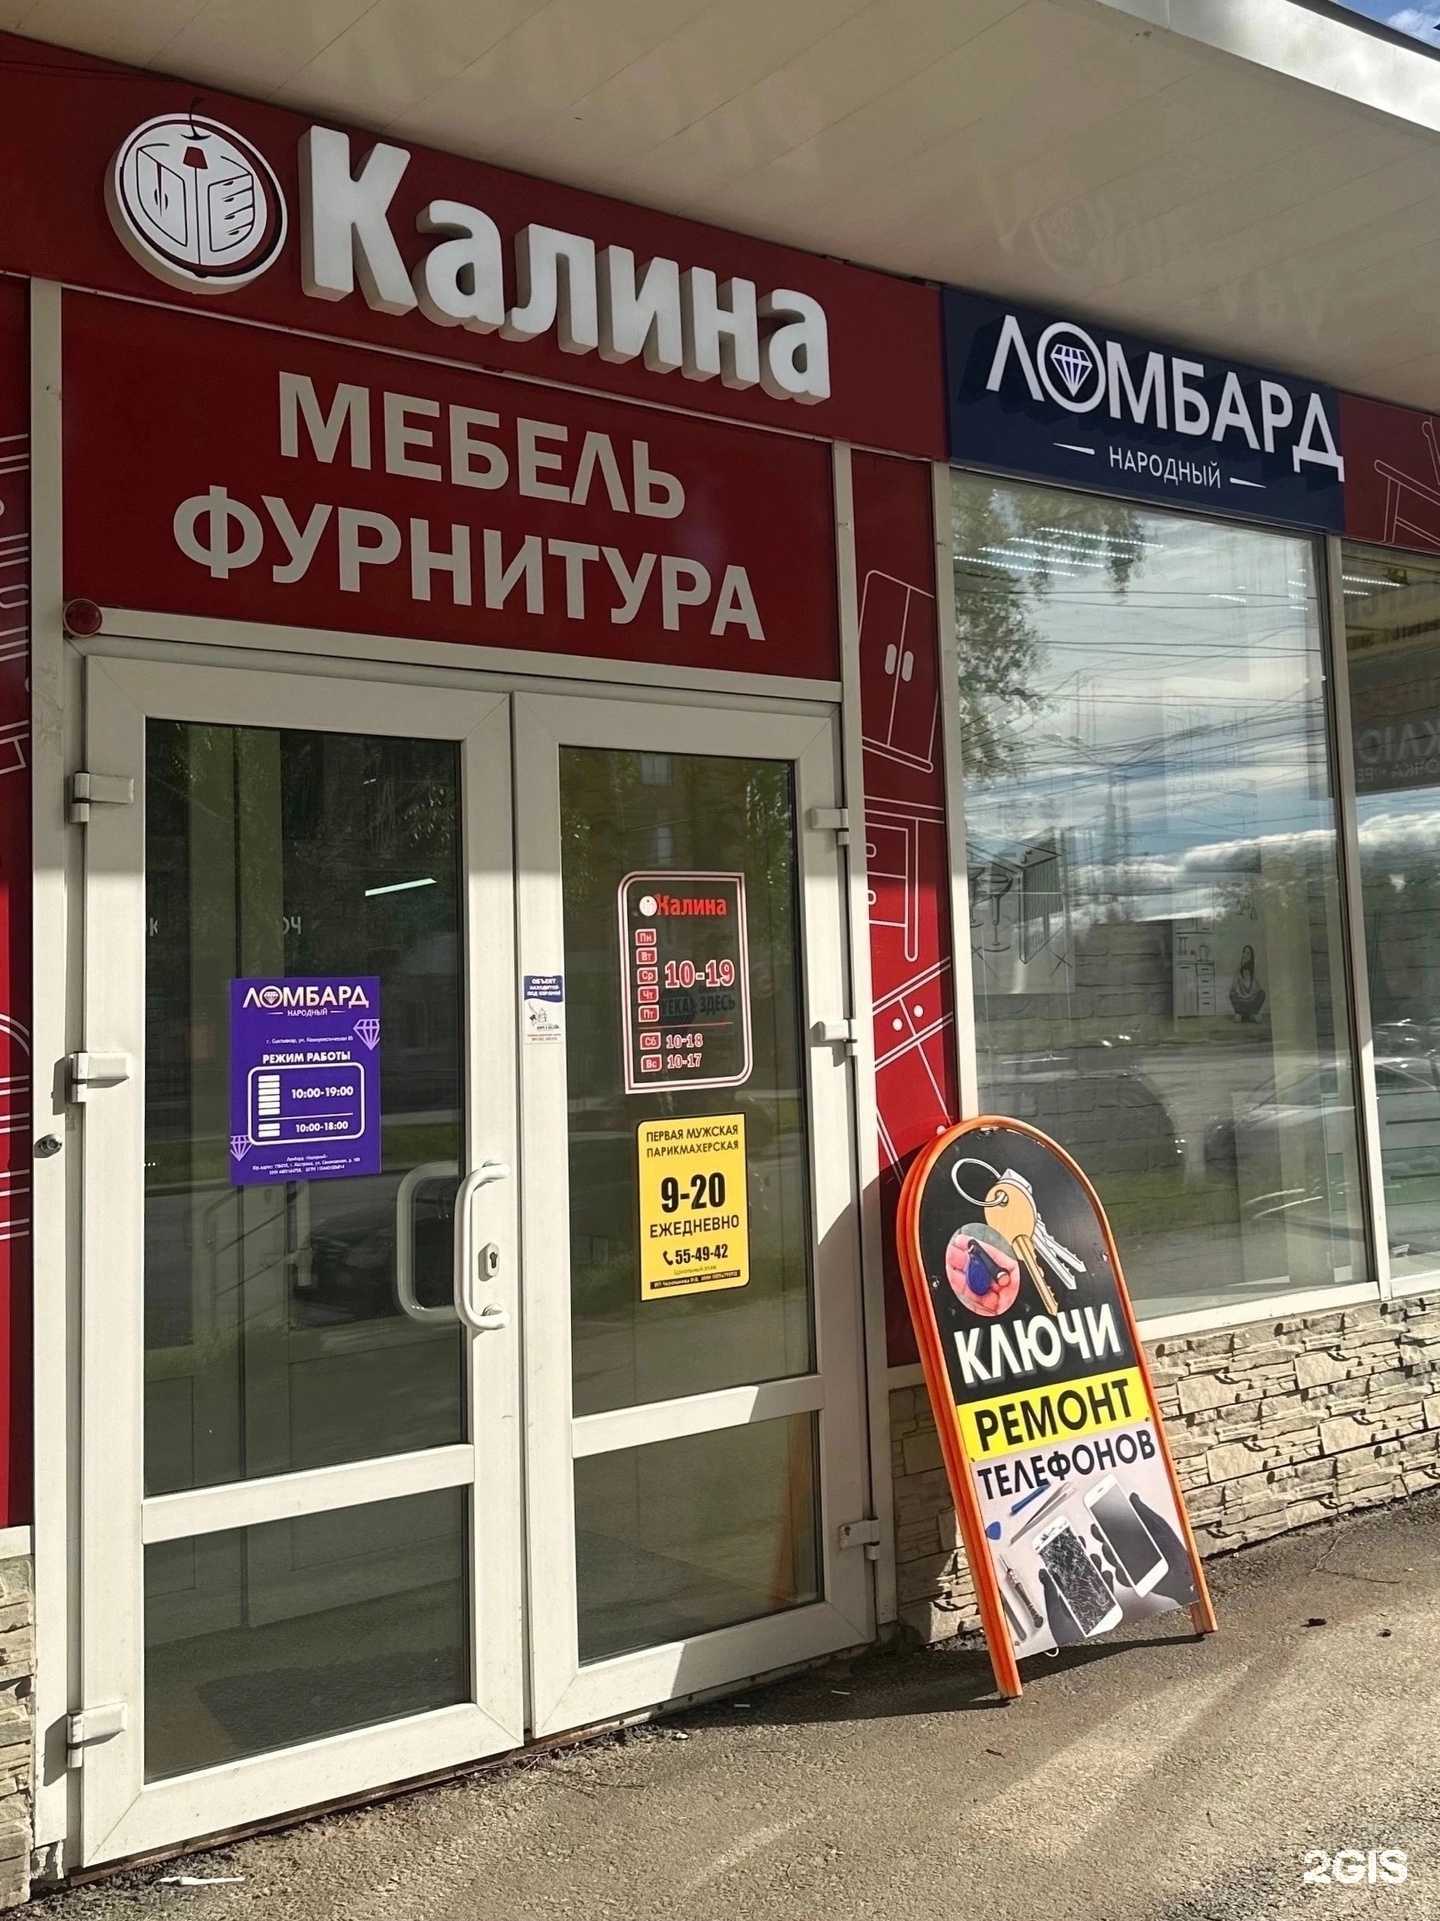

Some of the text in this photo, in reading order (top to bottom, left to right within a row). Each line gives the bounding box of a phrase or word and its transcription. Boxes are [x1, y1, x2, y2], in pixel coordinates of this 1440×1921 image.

[298, 125, 832, 404] Калина
[986, 314, 1345, 482] ЛОМБАРД
[279, 371, 686, 519] МЕБЕЛЬ
[1109, 446, 1222, 489] НАРОДНЫЙ
[173, 485, 765, 640] ФУРНИТУРА
[656, 894, 727, 916] Калина
[665, 959, 735, 988] 10-19
[243, 985, 370, 1008] ЛОМБАРД
[287, 1008, 328, 1017] НАРОДНЫЙ
[666, 1034, 703, 1049] 10-18
[263, 1051, 351, 1064] РЕЖИМ РАБОТЫ
[667, 1053, 702, 1069] 10-17
[292, 1086, 354, 1099] 10:00-19:00
[295, 1121, 349, 1133] 10:00-18:00
[646, 1124, 739, 1143] ПЕРВАЯ МУЖСКАЯ
[646, 1140, 739, 1158] ПАРИКМАХЕРСКАЯ
[661, 1172, 726, 1213] 9-20
[650, 1215, 739, 1238] ЕЖЕДНЕВНО
[675, 1244, 728, 1265] 55-49-42
[953, 1303, 1122, 1386] КЛЮЧИ
[974, 1378, 1135, 1452] РЕМОНТ
[977, 1428, 1156, 1500] ТЕЛЕФОНОВ
